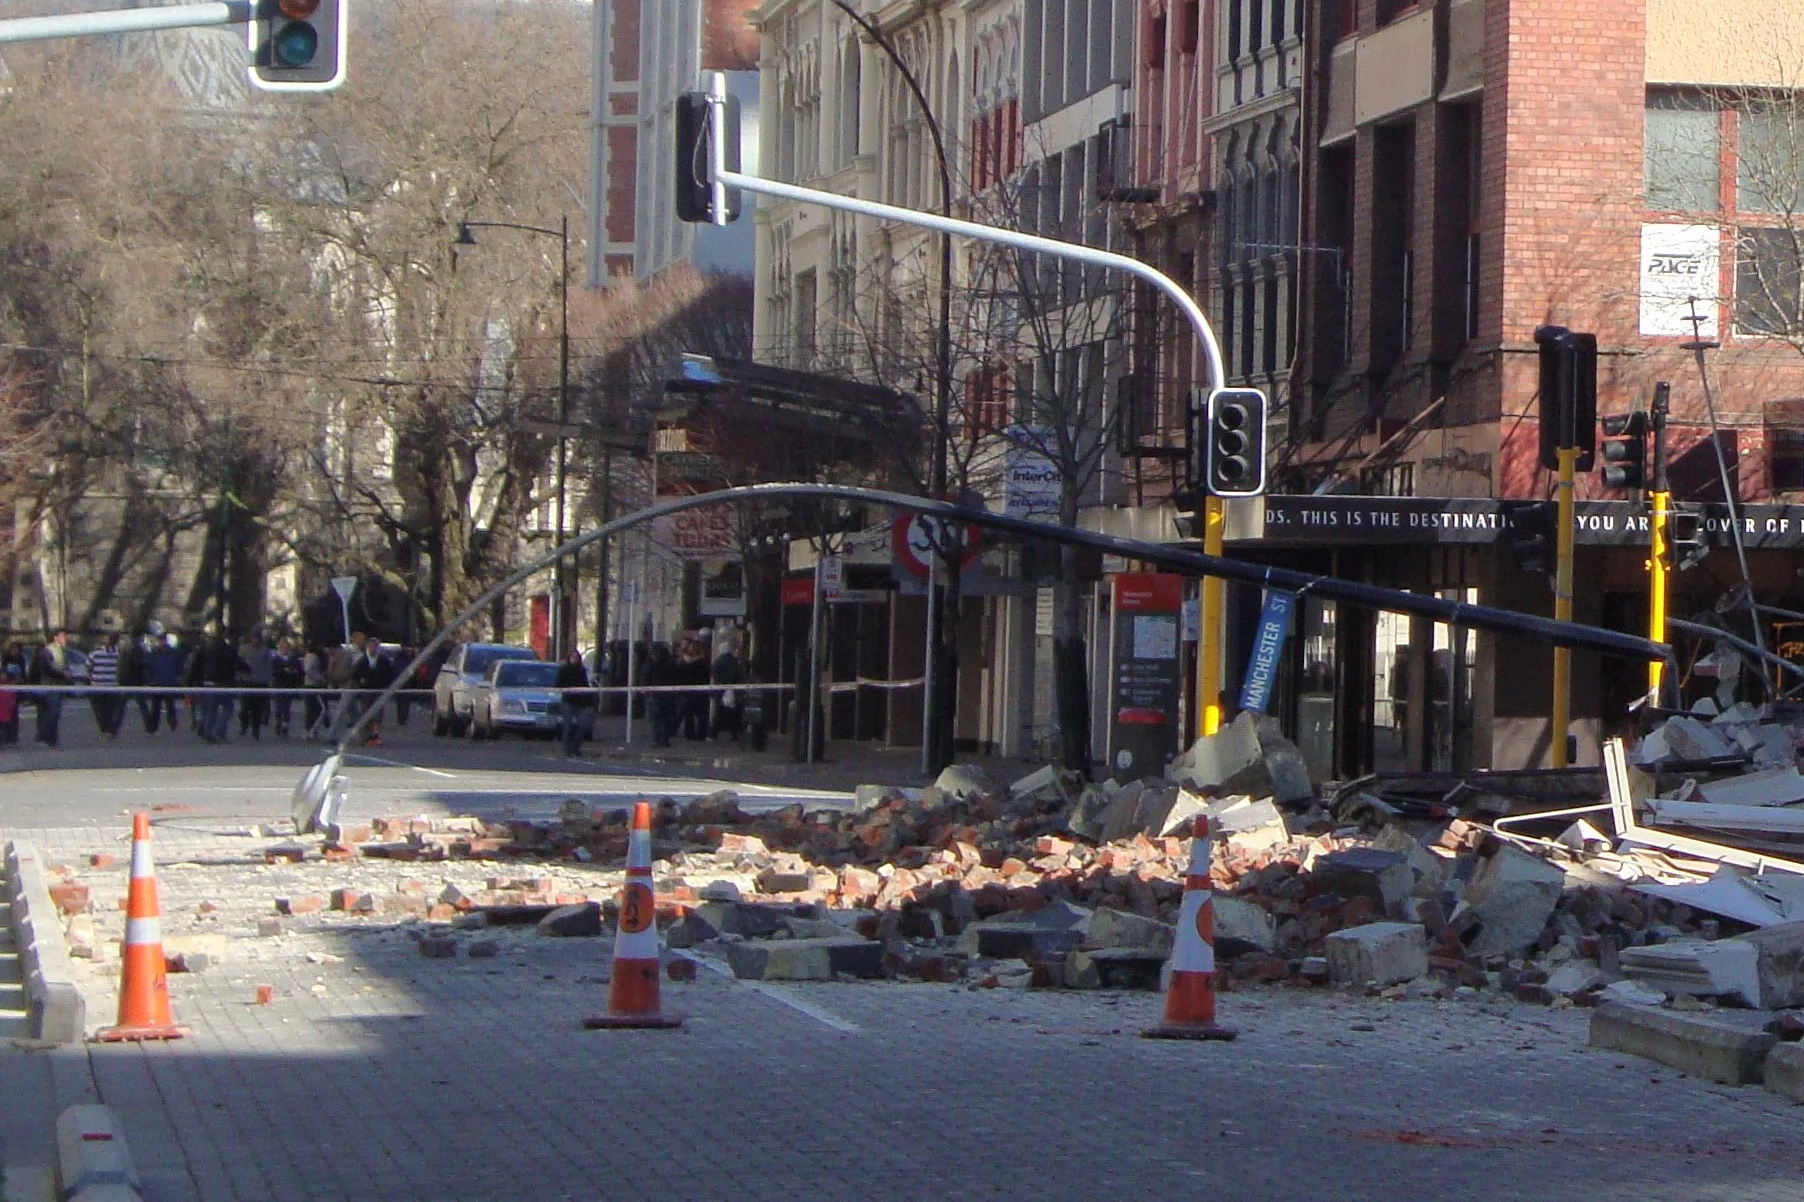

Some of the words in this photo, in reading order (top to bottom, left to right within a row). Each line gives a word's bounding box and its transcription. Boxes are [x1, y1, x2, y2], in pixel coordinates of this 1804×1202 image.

[1301, 510, 1337, 525] THIS
[1347, 511, 1362, 526] IS
[1371, 511, 1400, 527] THE
[1410, 512, 1515, 529] DESTINATI
[1577, 515, 1614, 531] YOU
[1625, 515, 1649, 531] AR
[1697, 517, 1755, 533] OVER
[1766, 518, 1789, 534] OF
[1245, 621, 1281, 709] MANCHESTER
[1271, 594, 1287, 614] ST
